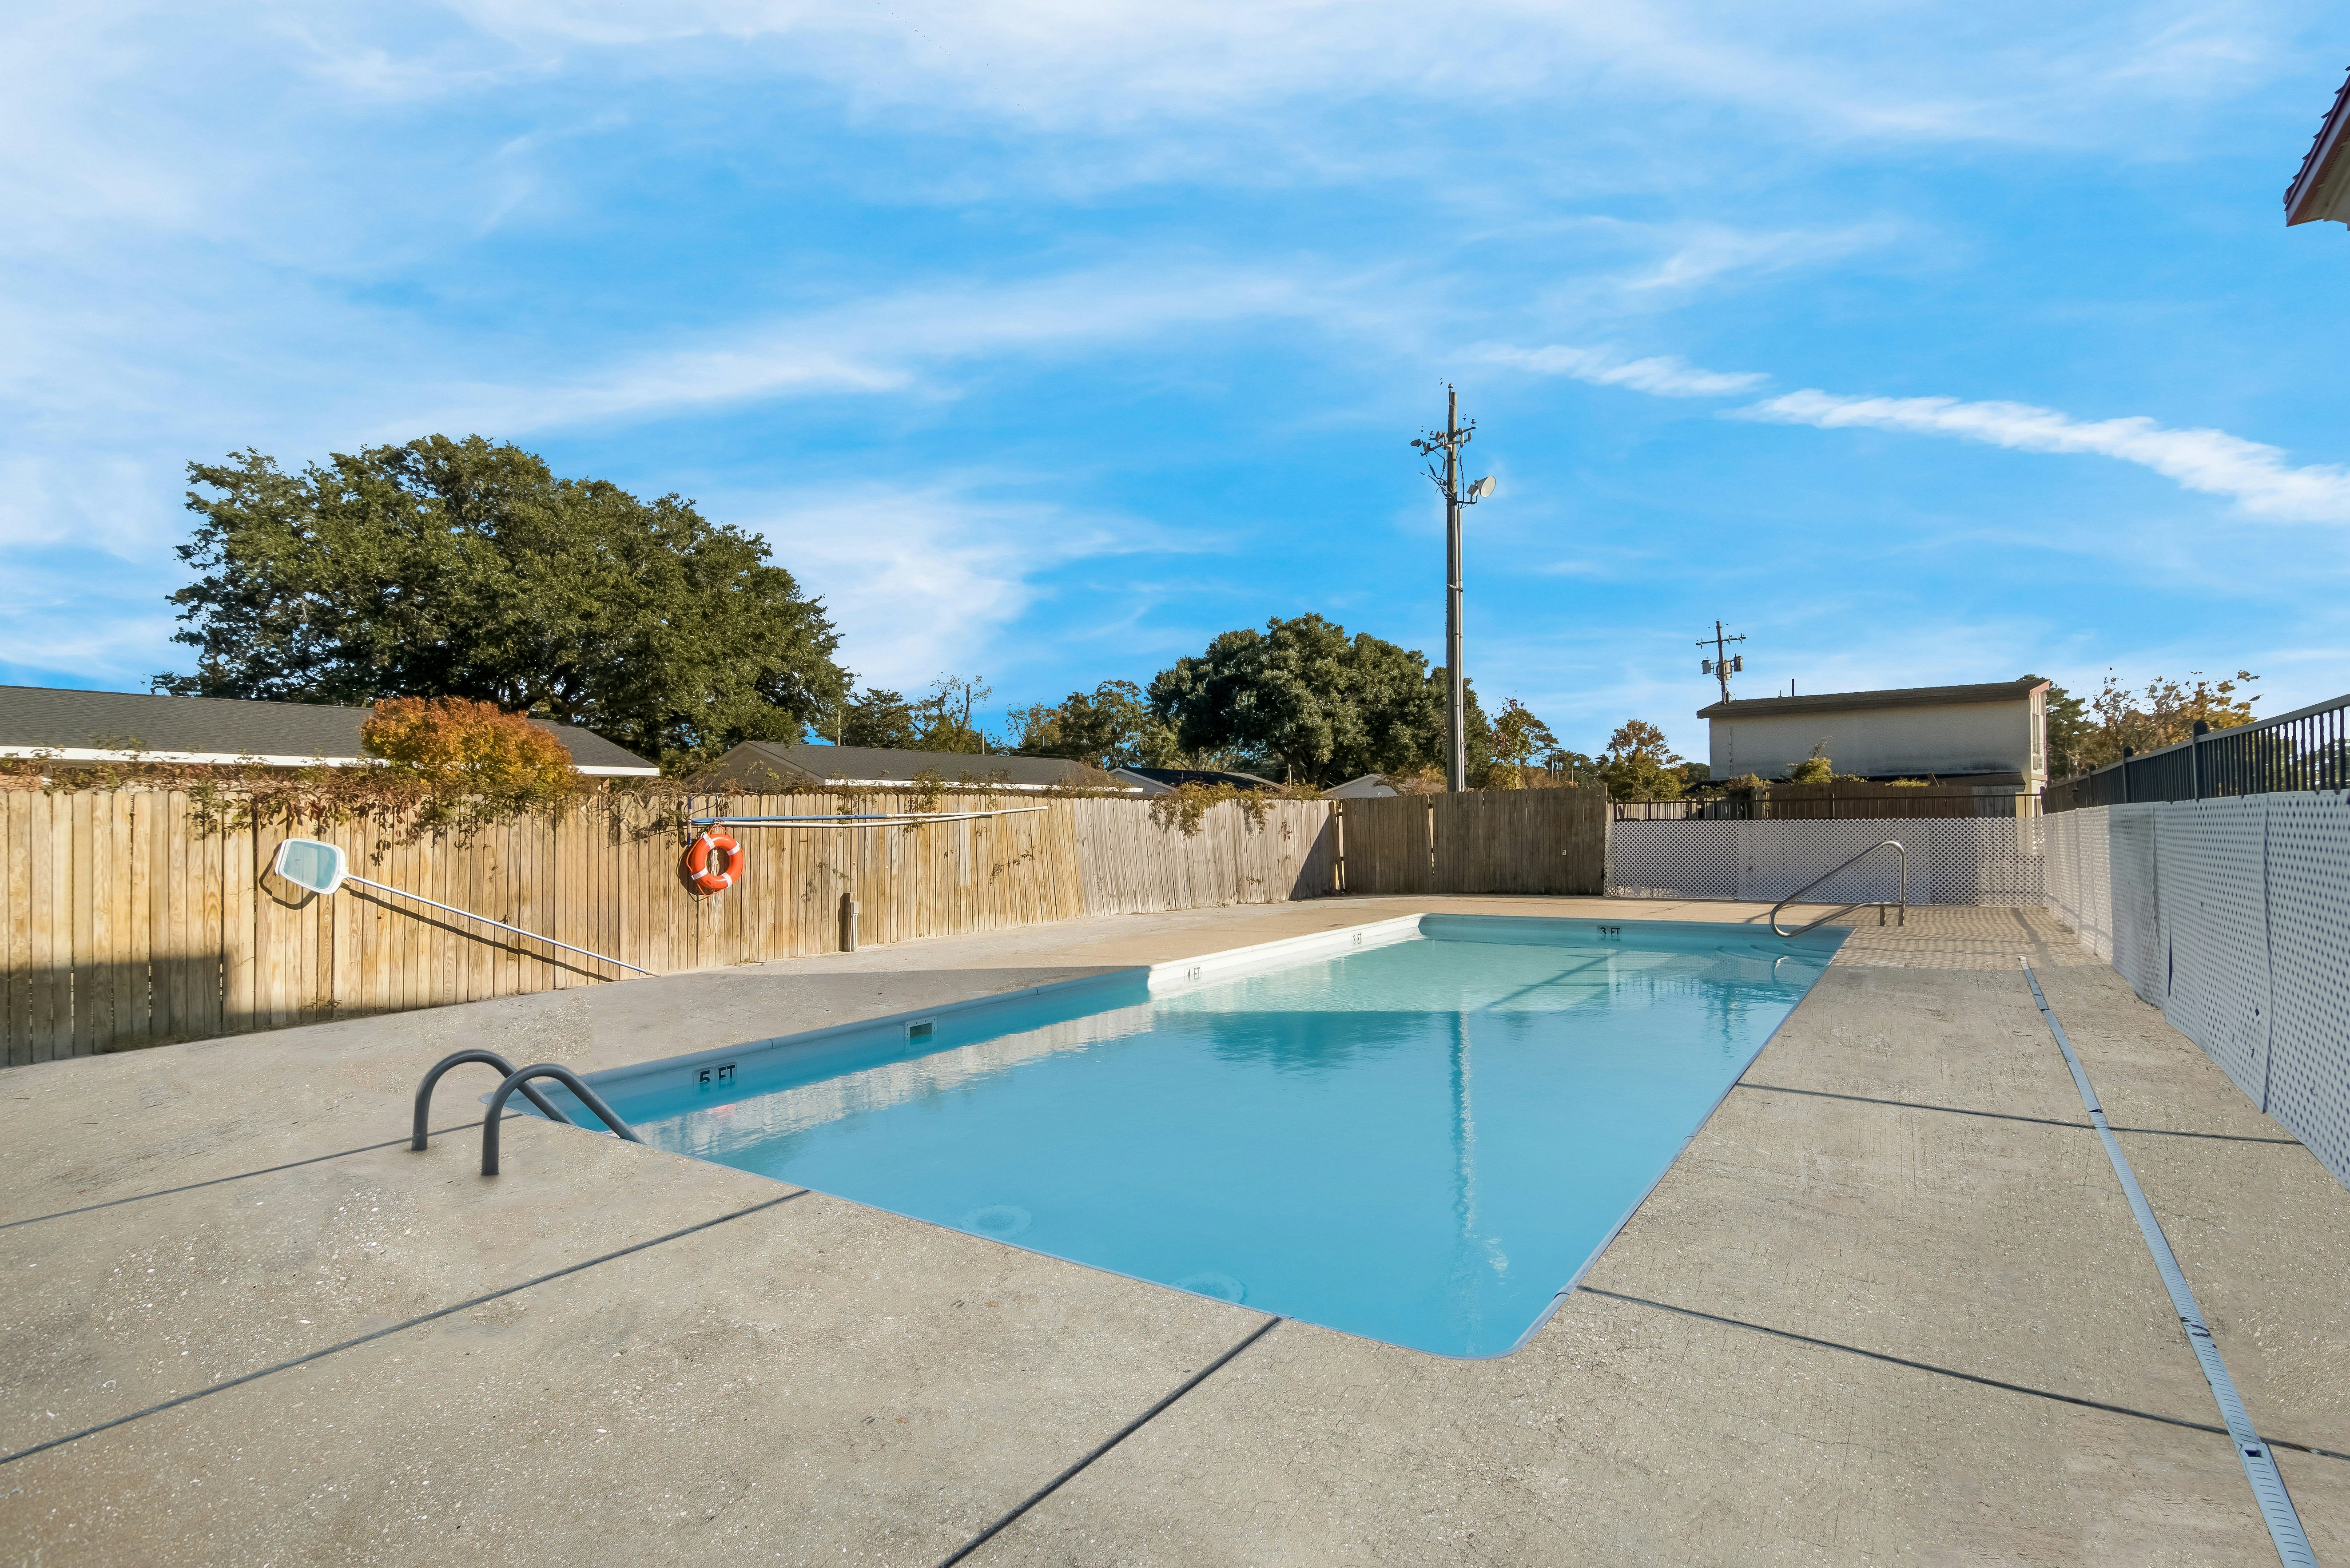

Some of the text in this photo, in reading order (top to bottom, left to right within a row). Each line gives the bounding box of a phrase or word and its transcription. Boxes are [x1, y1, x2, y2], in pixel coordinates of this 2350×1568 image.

[1610, 927, 1620, 936] FT
[1194, 967, 1200, 977] FT
[699, 1064, 736, 1084] 5 FT
